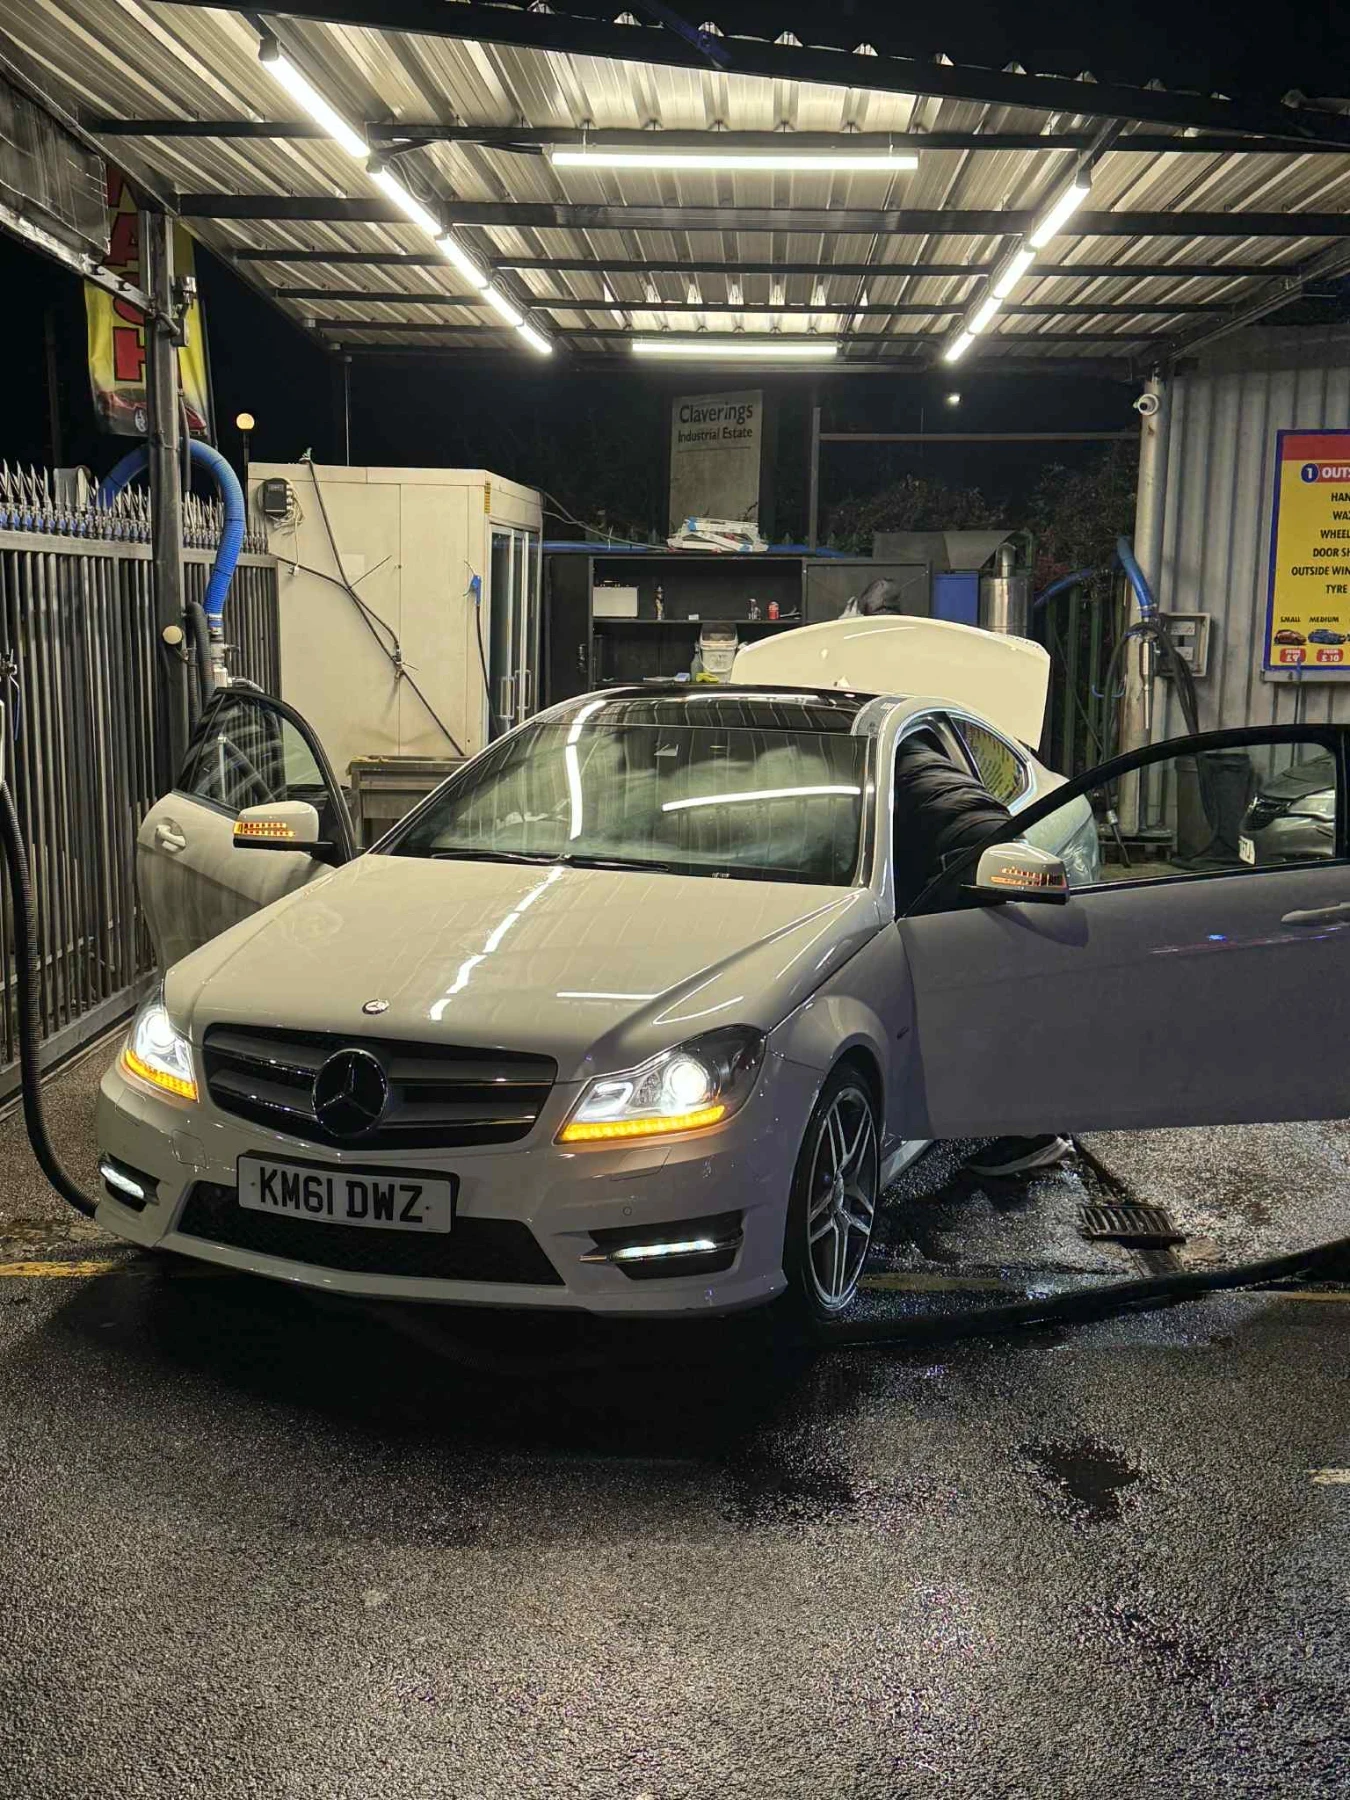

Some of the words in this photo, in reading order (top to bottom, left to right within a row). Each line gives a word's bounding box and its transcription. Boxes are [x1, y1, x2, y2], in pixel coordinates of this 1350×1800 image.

[679, 402, 753, 425] Claverings
[678, 426, 720, 444] Industrial
[722, 426, 753, 440] Estate
[1306, 467, 1313, 479] 1
[1313, 547, 1339, 557] DOOR
[1291, 566, 1330, 576] OUTSIDE
[1326, 584, 1348, 594] TYRE
[259, 1166, 334, 1216] KM61
[345, 1180, 424, 1223] DWZ
